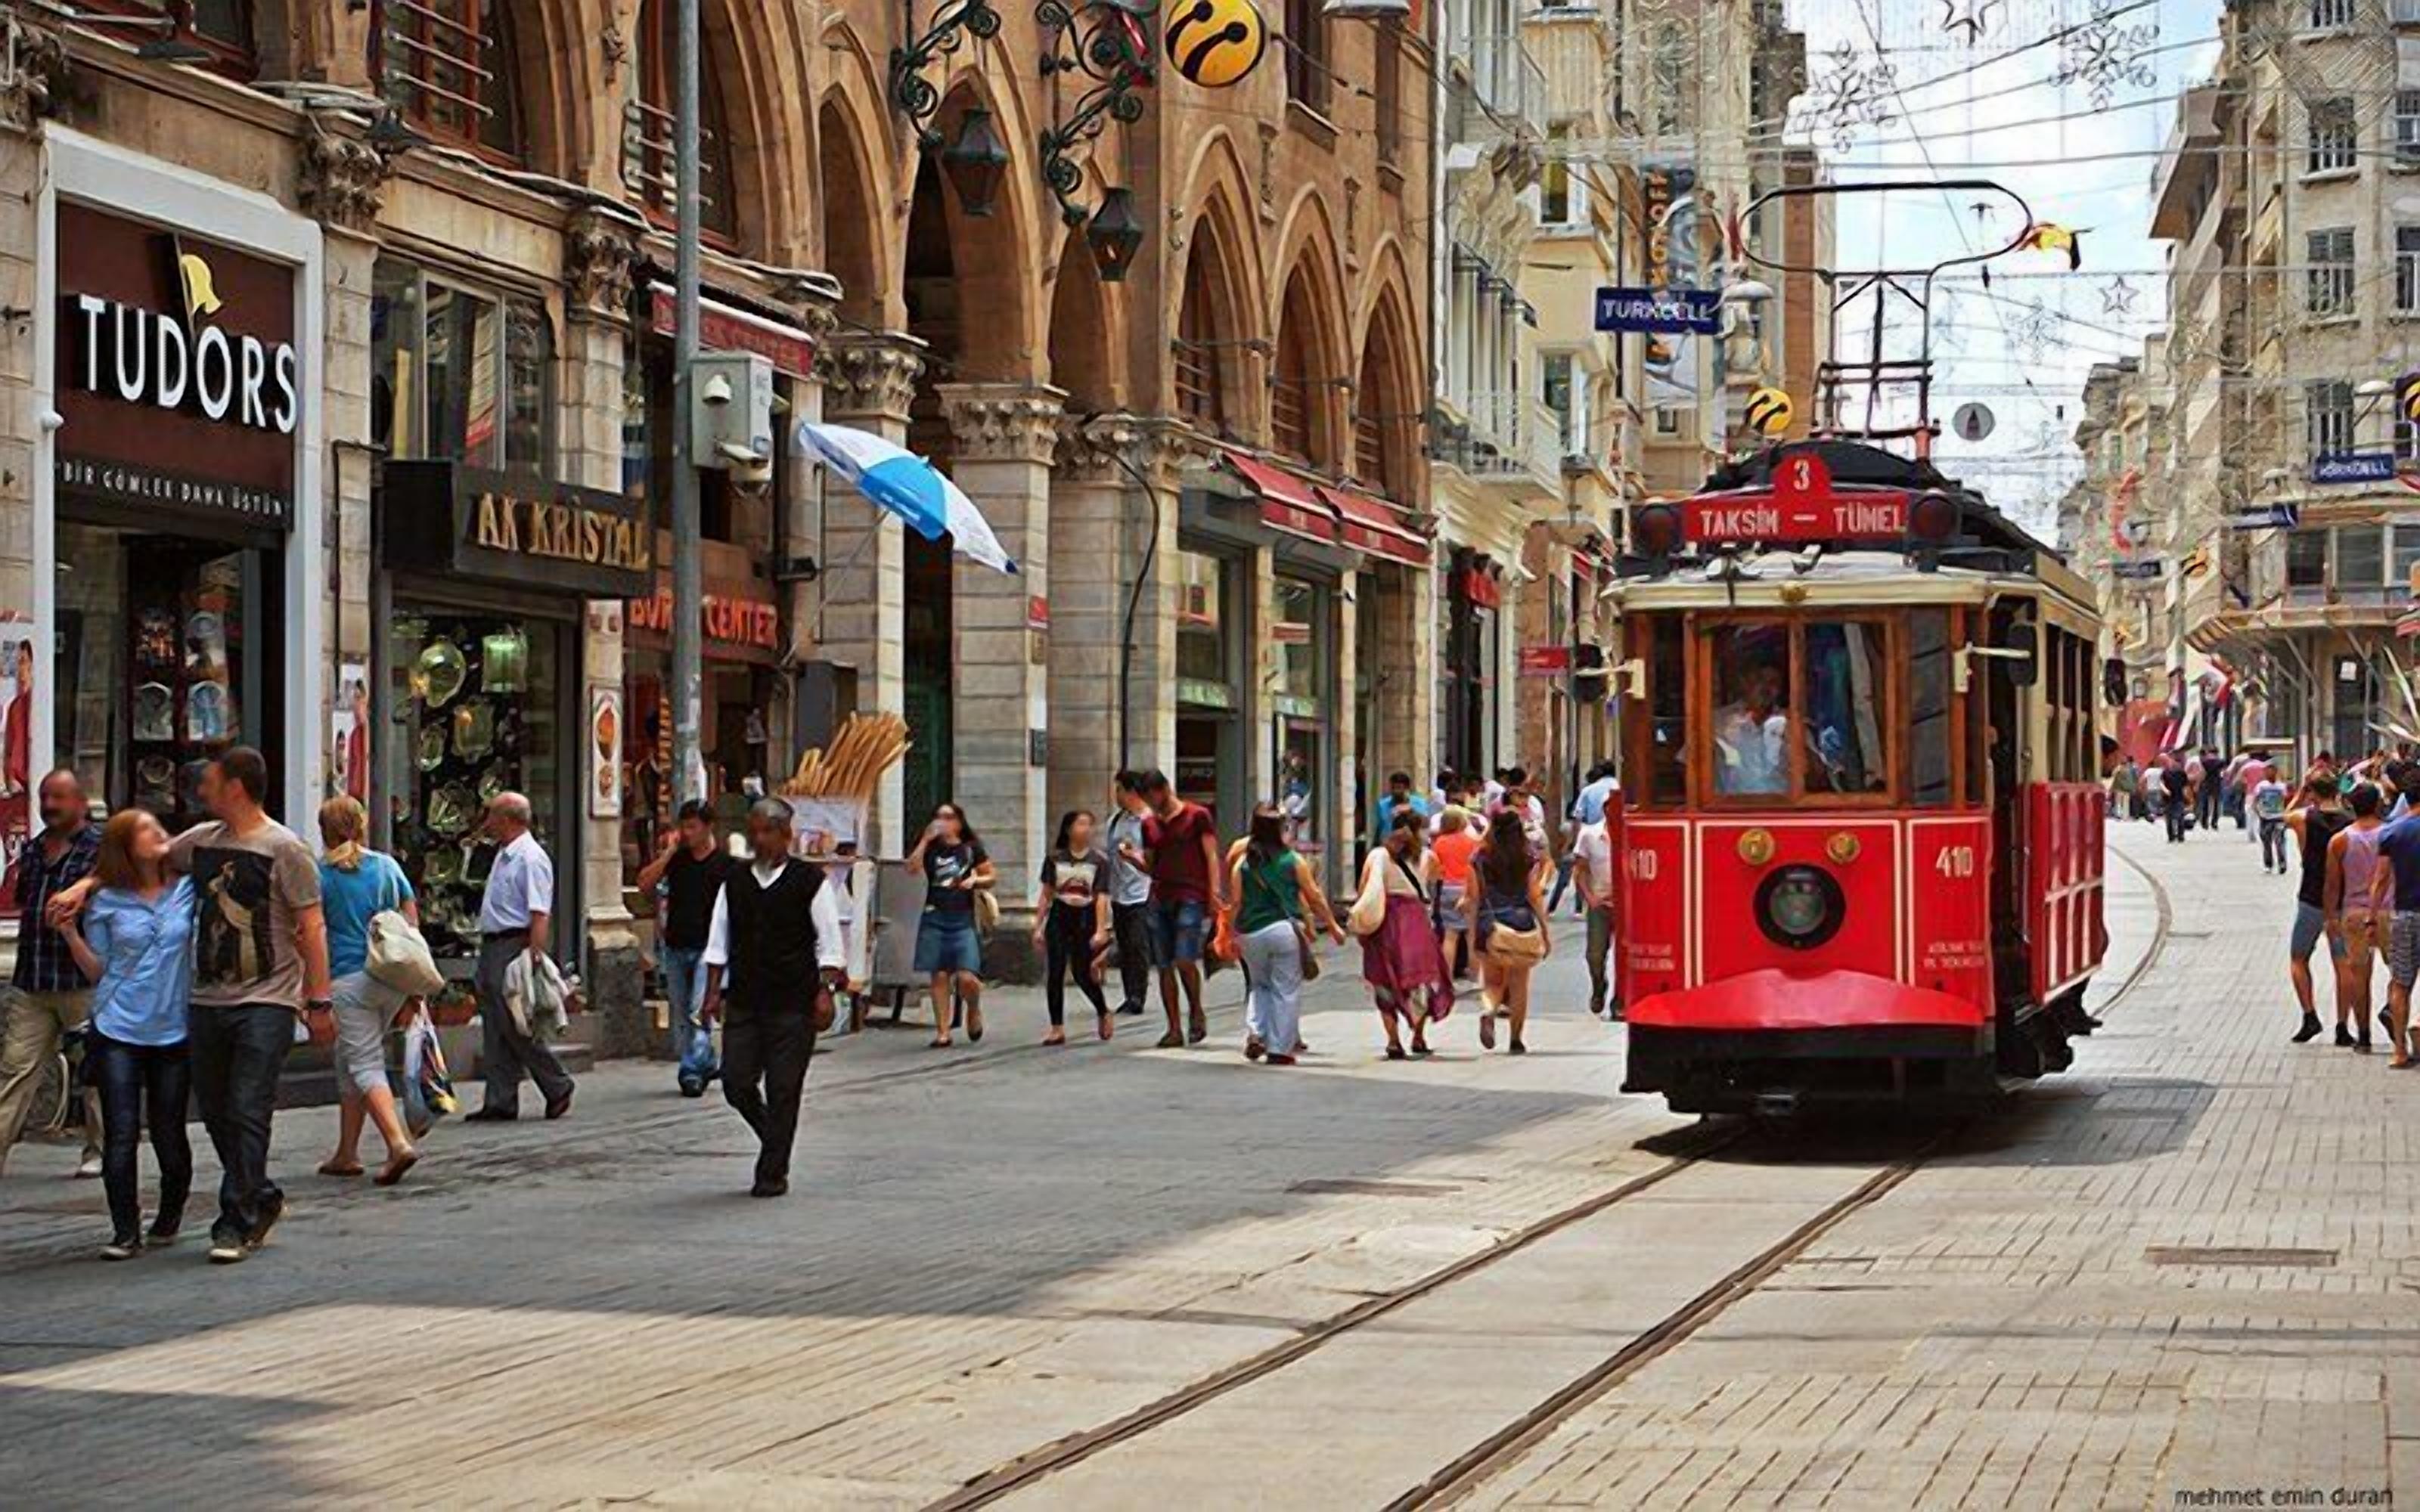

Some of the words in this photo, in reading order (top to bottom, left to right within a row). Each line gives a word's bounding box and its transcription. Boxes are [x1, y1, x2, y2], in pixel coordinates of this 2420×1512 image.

[79, 294, 296, 433] TUDORS
[1793, 459, 1810, 491] 3
[478, 493, 519, 552] AK
[528, 494, 649, 573] KRİSTAL
[1700, 502, 1778, 535] TAKSİM
[1936, 846, 1973, 878] 410
